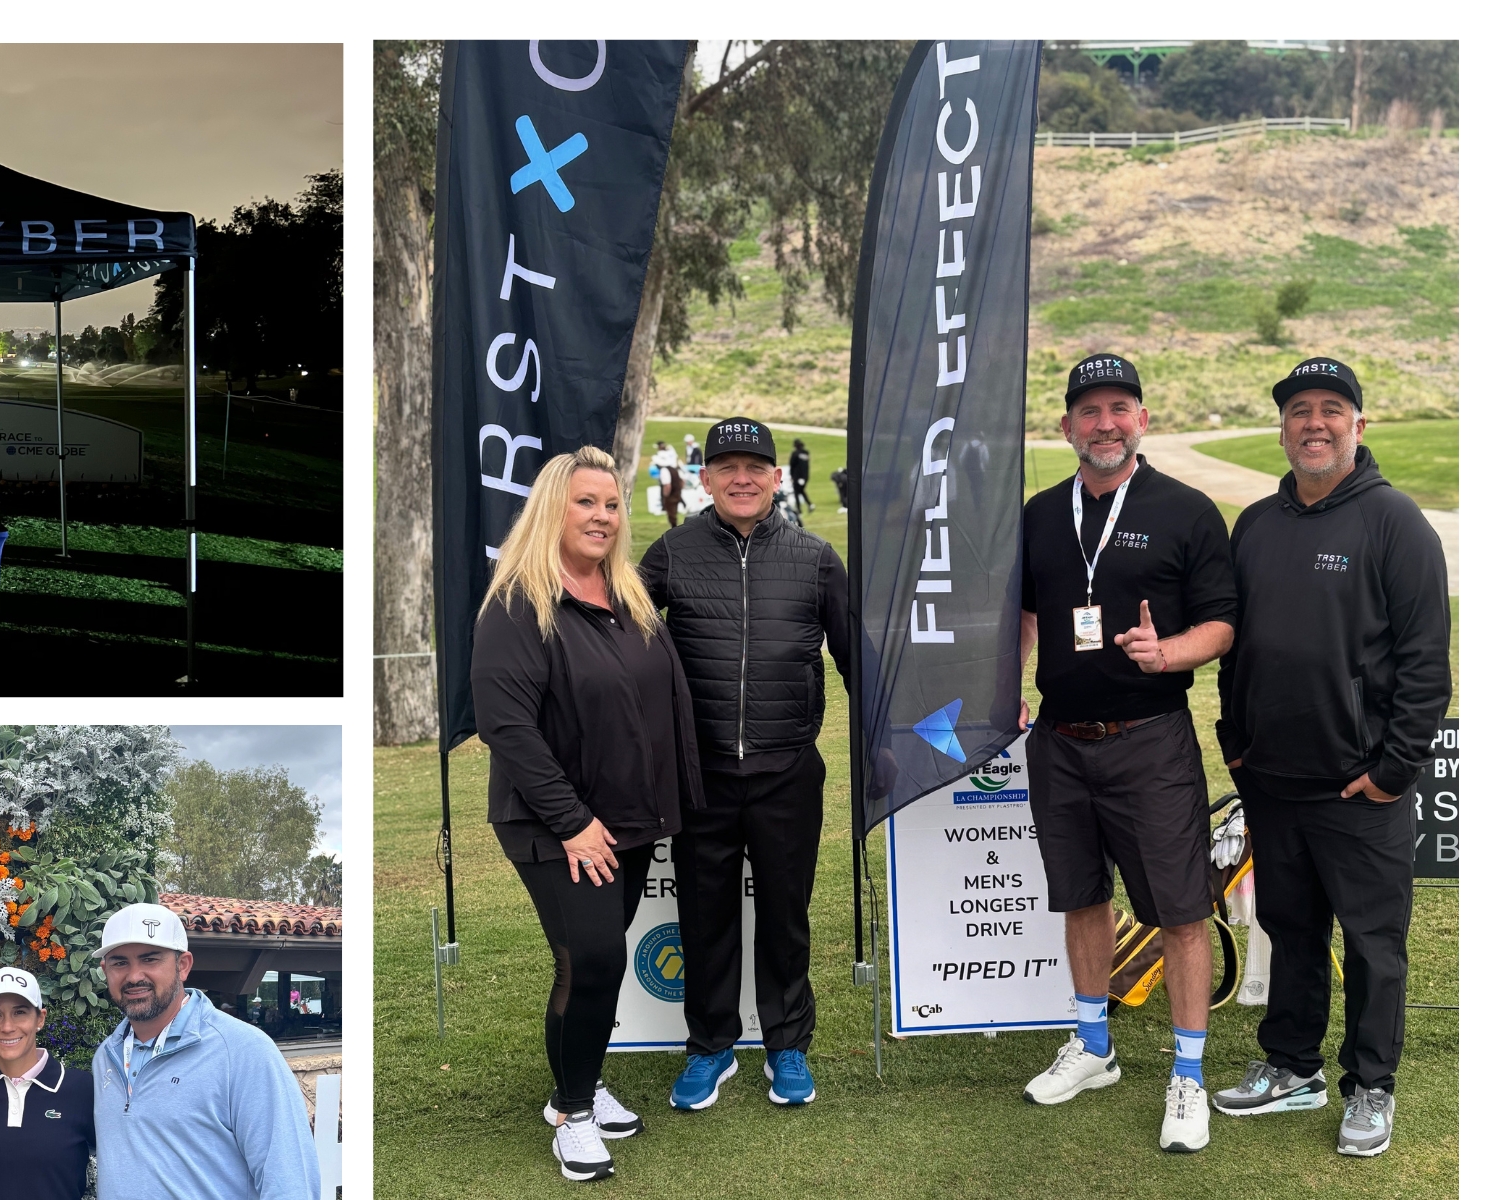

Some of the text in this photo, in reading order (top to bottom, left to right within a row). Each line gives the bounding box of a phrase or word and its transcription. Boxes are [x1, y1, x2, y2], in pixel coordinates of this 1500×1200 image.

[1079, 368, 1123, 384] CYBER
[0, 432, 32, 442] RACE
[718, 433, 760, 445] CYBER
[17, 446, 43, 455] CME
[1114, 540, 1148, 550] CYBER
[1314, 562, 1348, 572] CYBER
[982, 762, 1022, 776] Eagle
[967, 793, 1026, 801] CHAMPIONSHIP
[944, 825, 1038, 843] WOMEN'S
[986, 850, 1000, 865] &
[964, 873, 1023, 890] MEN'S
[950, 896, 1039, 914] LONGEST
[966, 921, 1024, 938] DRIVE
[932, 958, 1058, 982] "PIPED IT"
